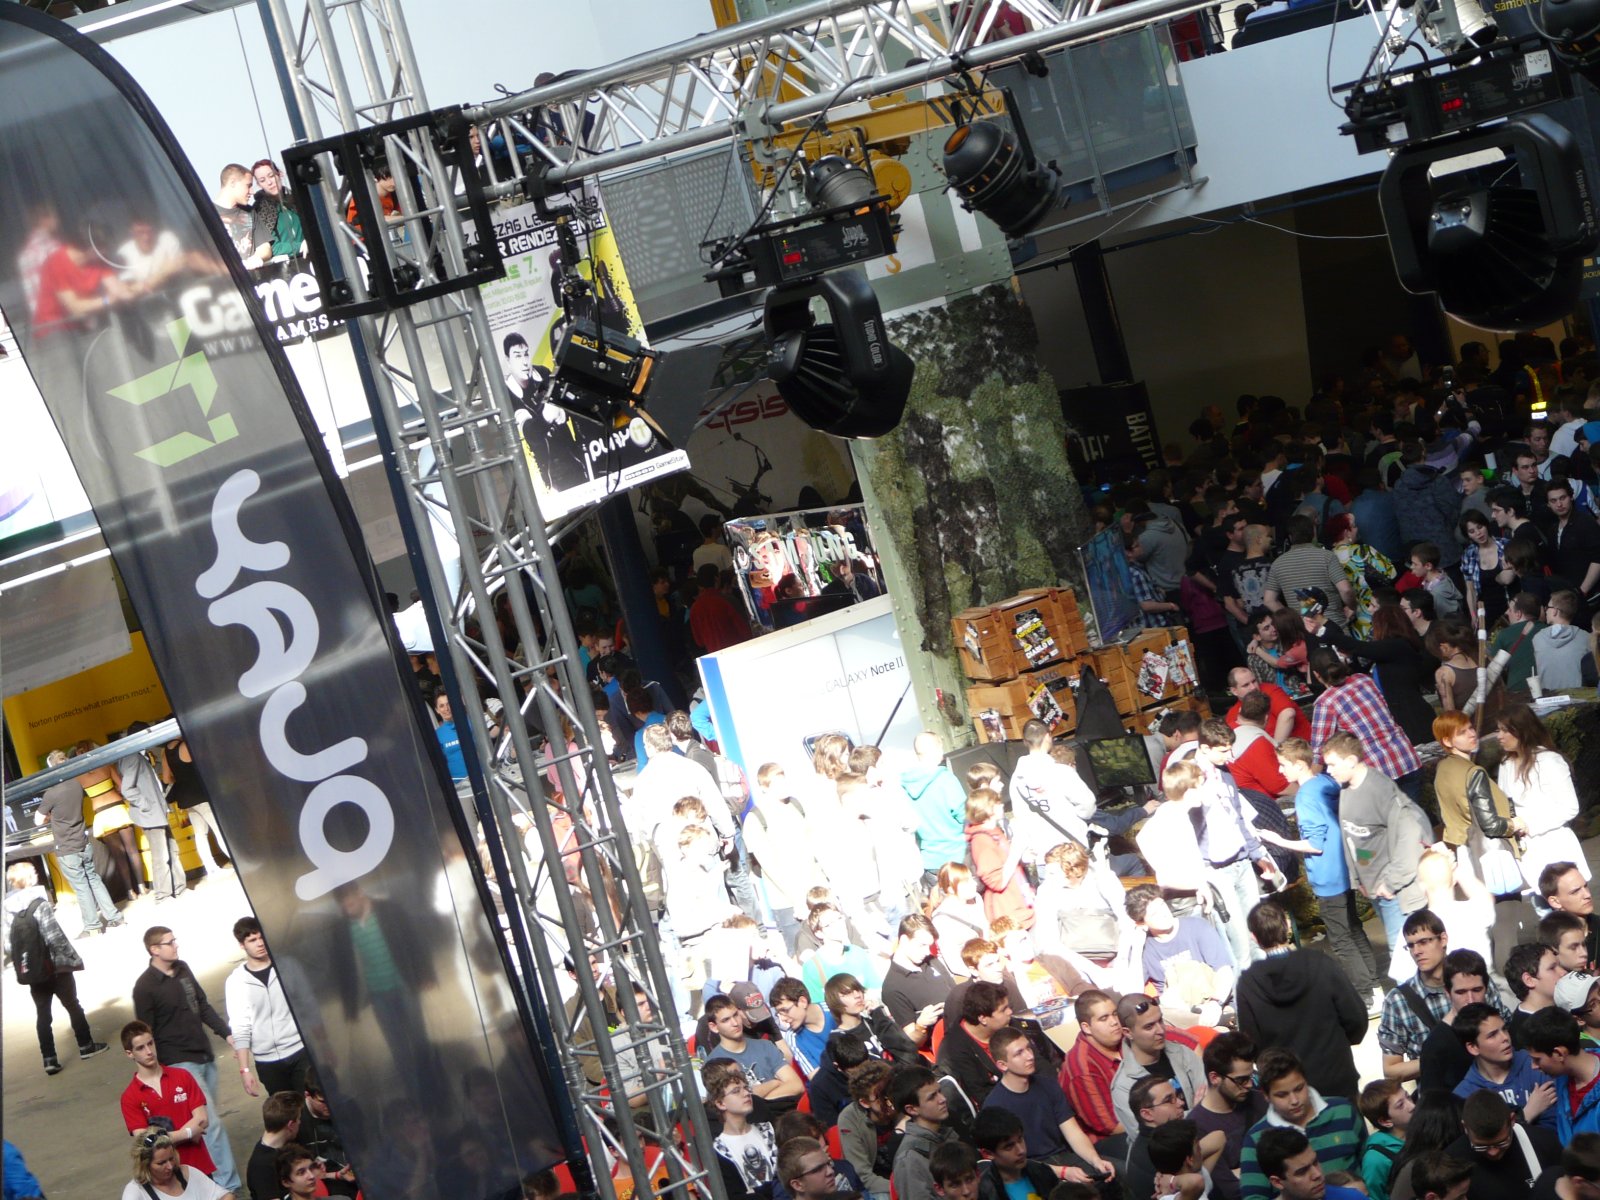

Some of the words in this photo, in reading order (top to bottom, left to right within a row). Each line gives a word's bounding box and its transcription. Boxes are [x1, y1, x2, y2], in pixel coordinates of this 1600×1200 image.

[825, 669, 868, 693] GALAXY
[870, 661, 896, 677] Note
[28, 715, 53, 730] Norton
[53, 706, 83, 723] protects
[83, 699, 101, 712] what
[101, 692, 130, 706] matters
